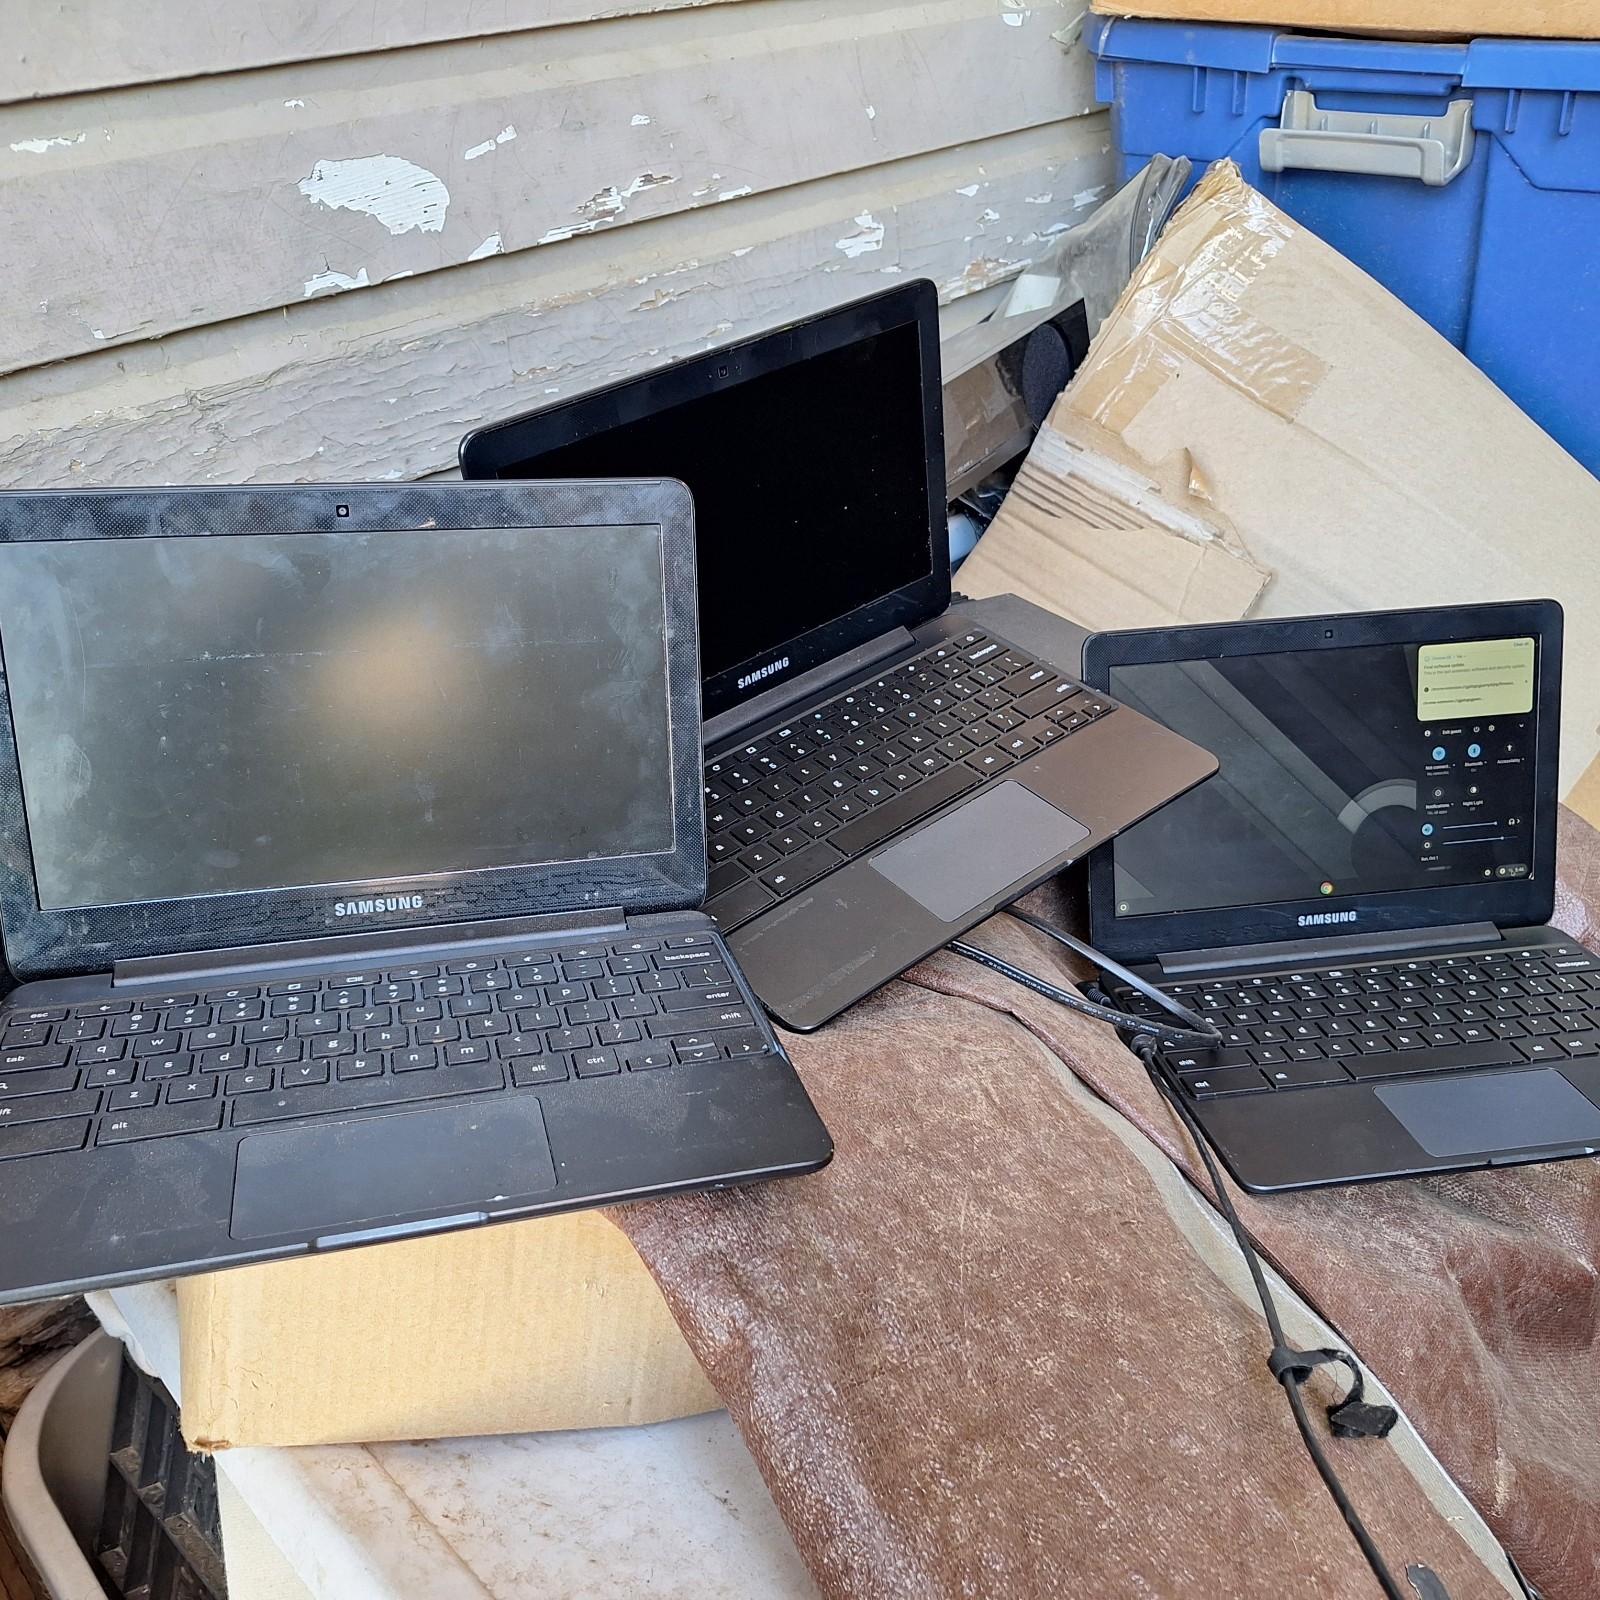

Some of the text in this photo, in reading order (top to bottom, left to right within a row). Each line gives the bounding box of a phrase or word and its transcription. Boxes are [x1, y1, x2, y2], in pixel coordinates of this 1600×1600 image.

[737, 657, 789, 689] SAMSUNG
[334, 895, 423, 917] SAMSUNG
[1298, 911, 1357, 927] SAMSUNG
[664, 951, 710, 961] backspace
[6, 1055, 25, 1063] tab
[151, 1038, 165, 1046] w
[364, 1012, 374, 1020] y
[705, 991, 730, 999] enter
[30, 1011, 49, 1019] esc
[187, 1083, 197, 1091] x
[355, 1060, 366, 1068] b
[720, 1012, 742, 1020] shift
[220, 1052, 229, 1061] d
[328, 1040, 339, 1048] g
[381, 1032, 391, 1040] h
[484, 1019, 494, 1027] k
[111, 1056, 605, 1130] alt alt ctrl
